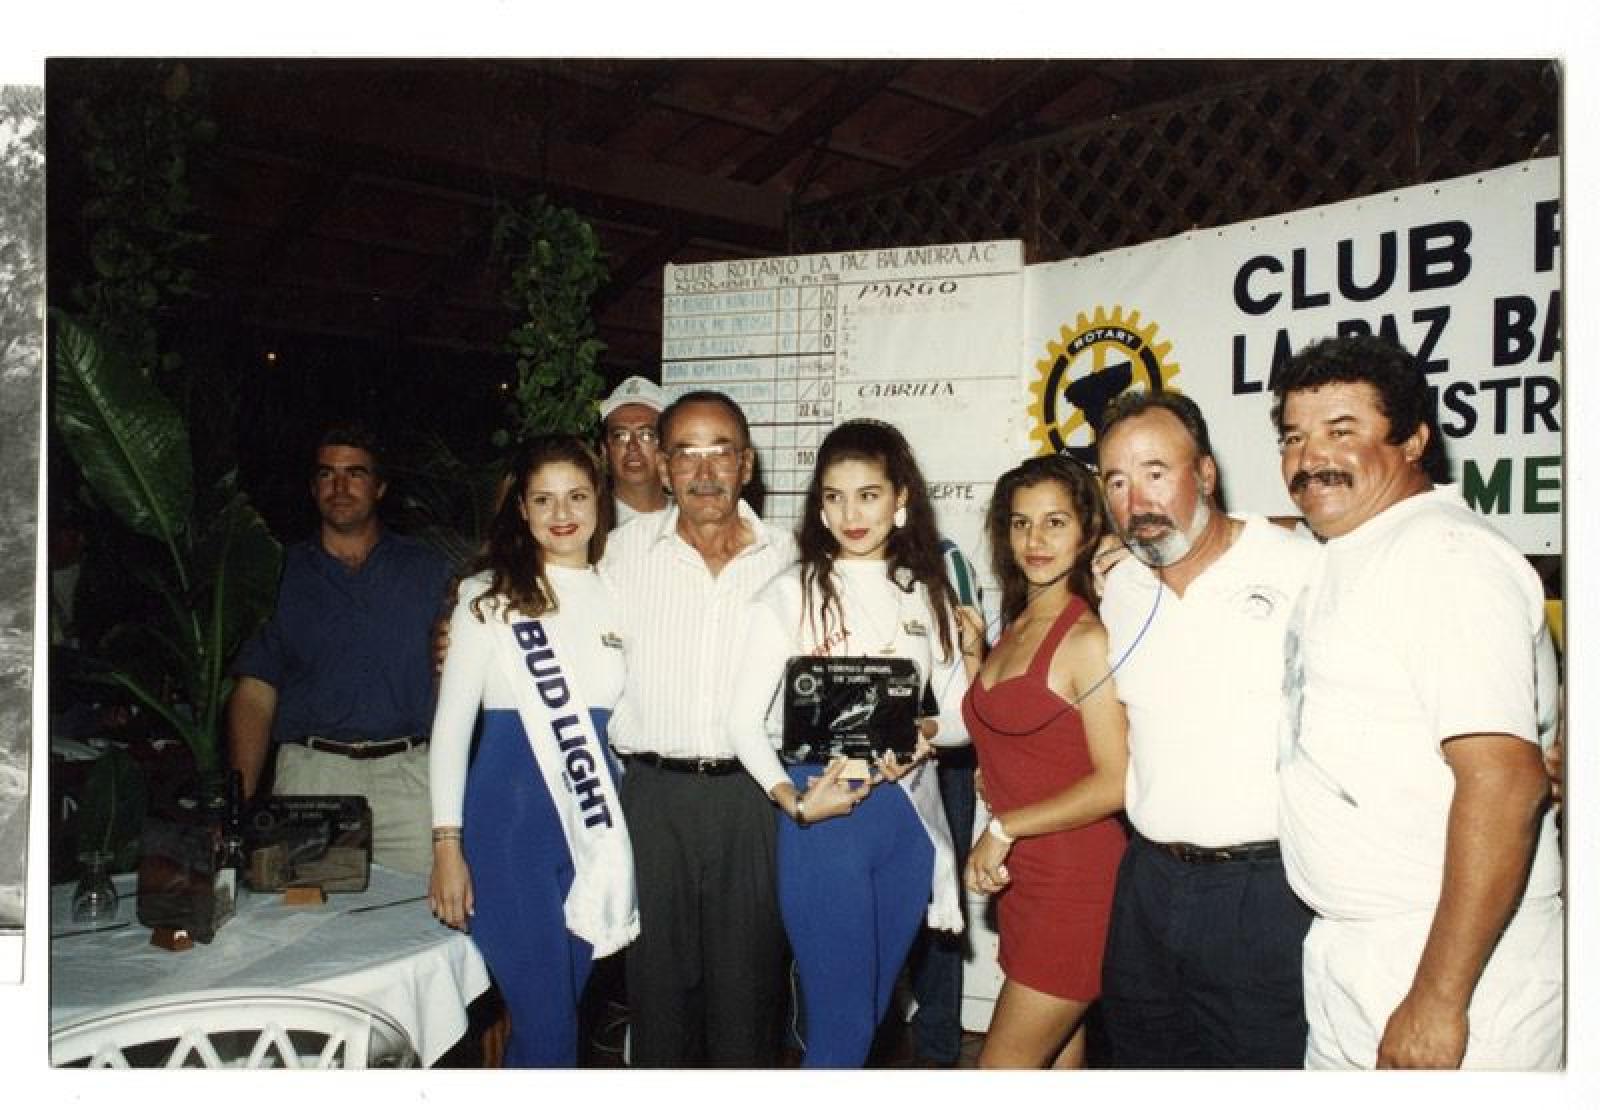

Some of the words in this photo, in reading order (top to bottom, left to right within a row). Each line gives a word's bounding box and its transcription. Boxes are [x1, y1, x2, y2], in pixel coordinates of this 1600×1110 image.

[674, 266, 715, 283] CLUB
[728, 259, 799, 279] ROTARIO
[809, 255, 832, 274] LA
[840, 253, 869, 271] PAZ
[1233, 219, 1472, 316] CLUB
[858, 281, 958, 299] PARGO
[1073, 328, 1135, 348] ROTARY
[512, 619, 571, 709] BUD
[551, 715, 613, 829] LIGHT
